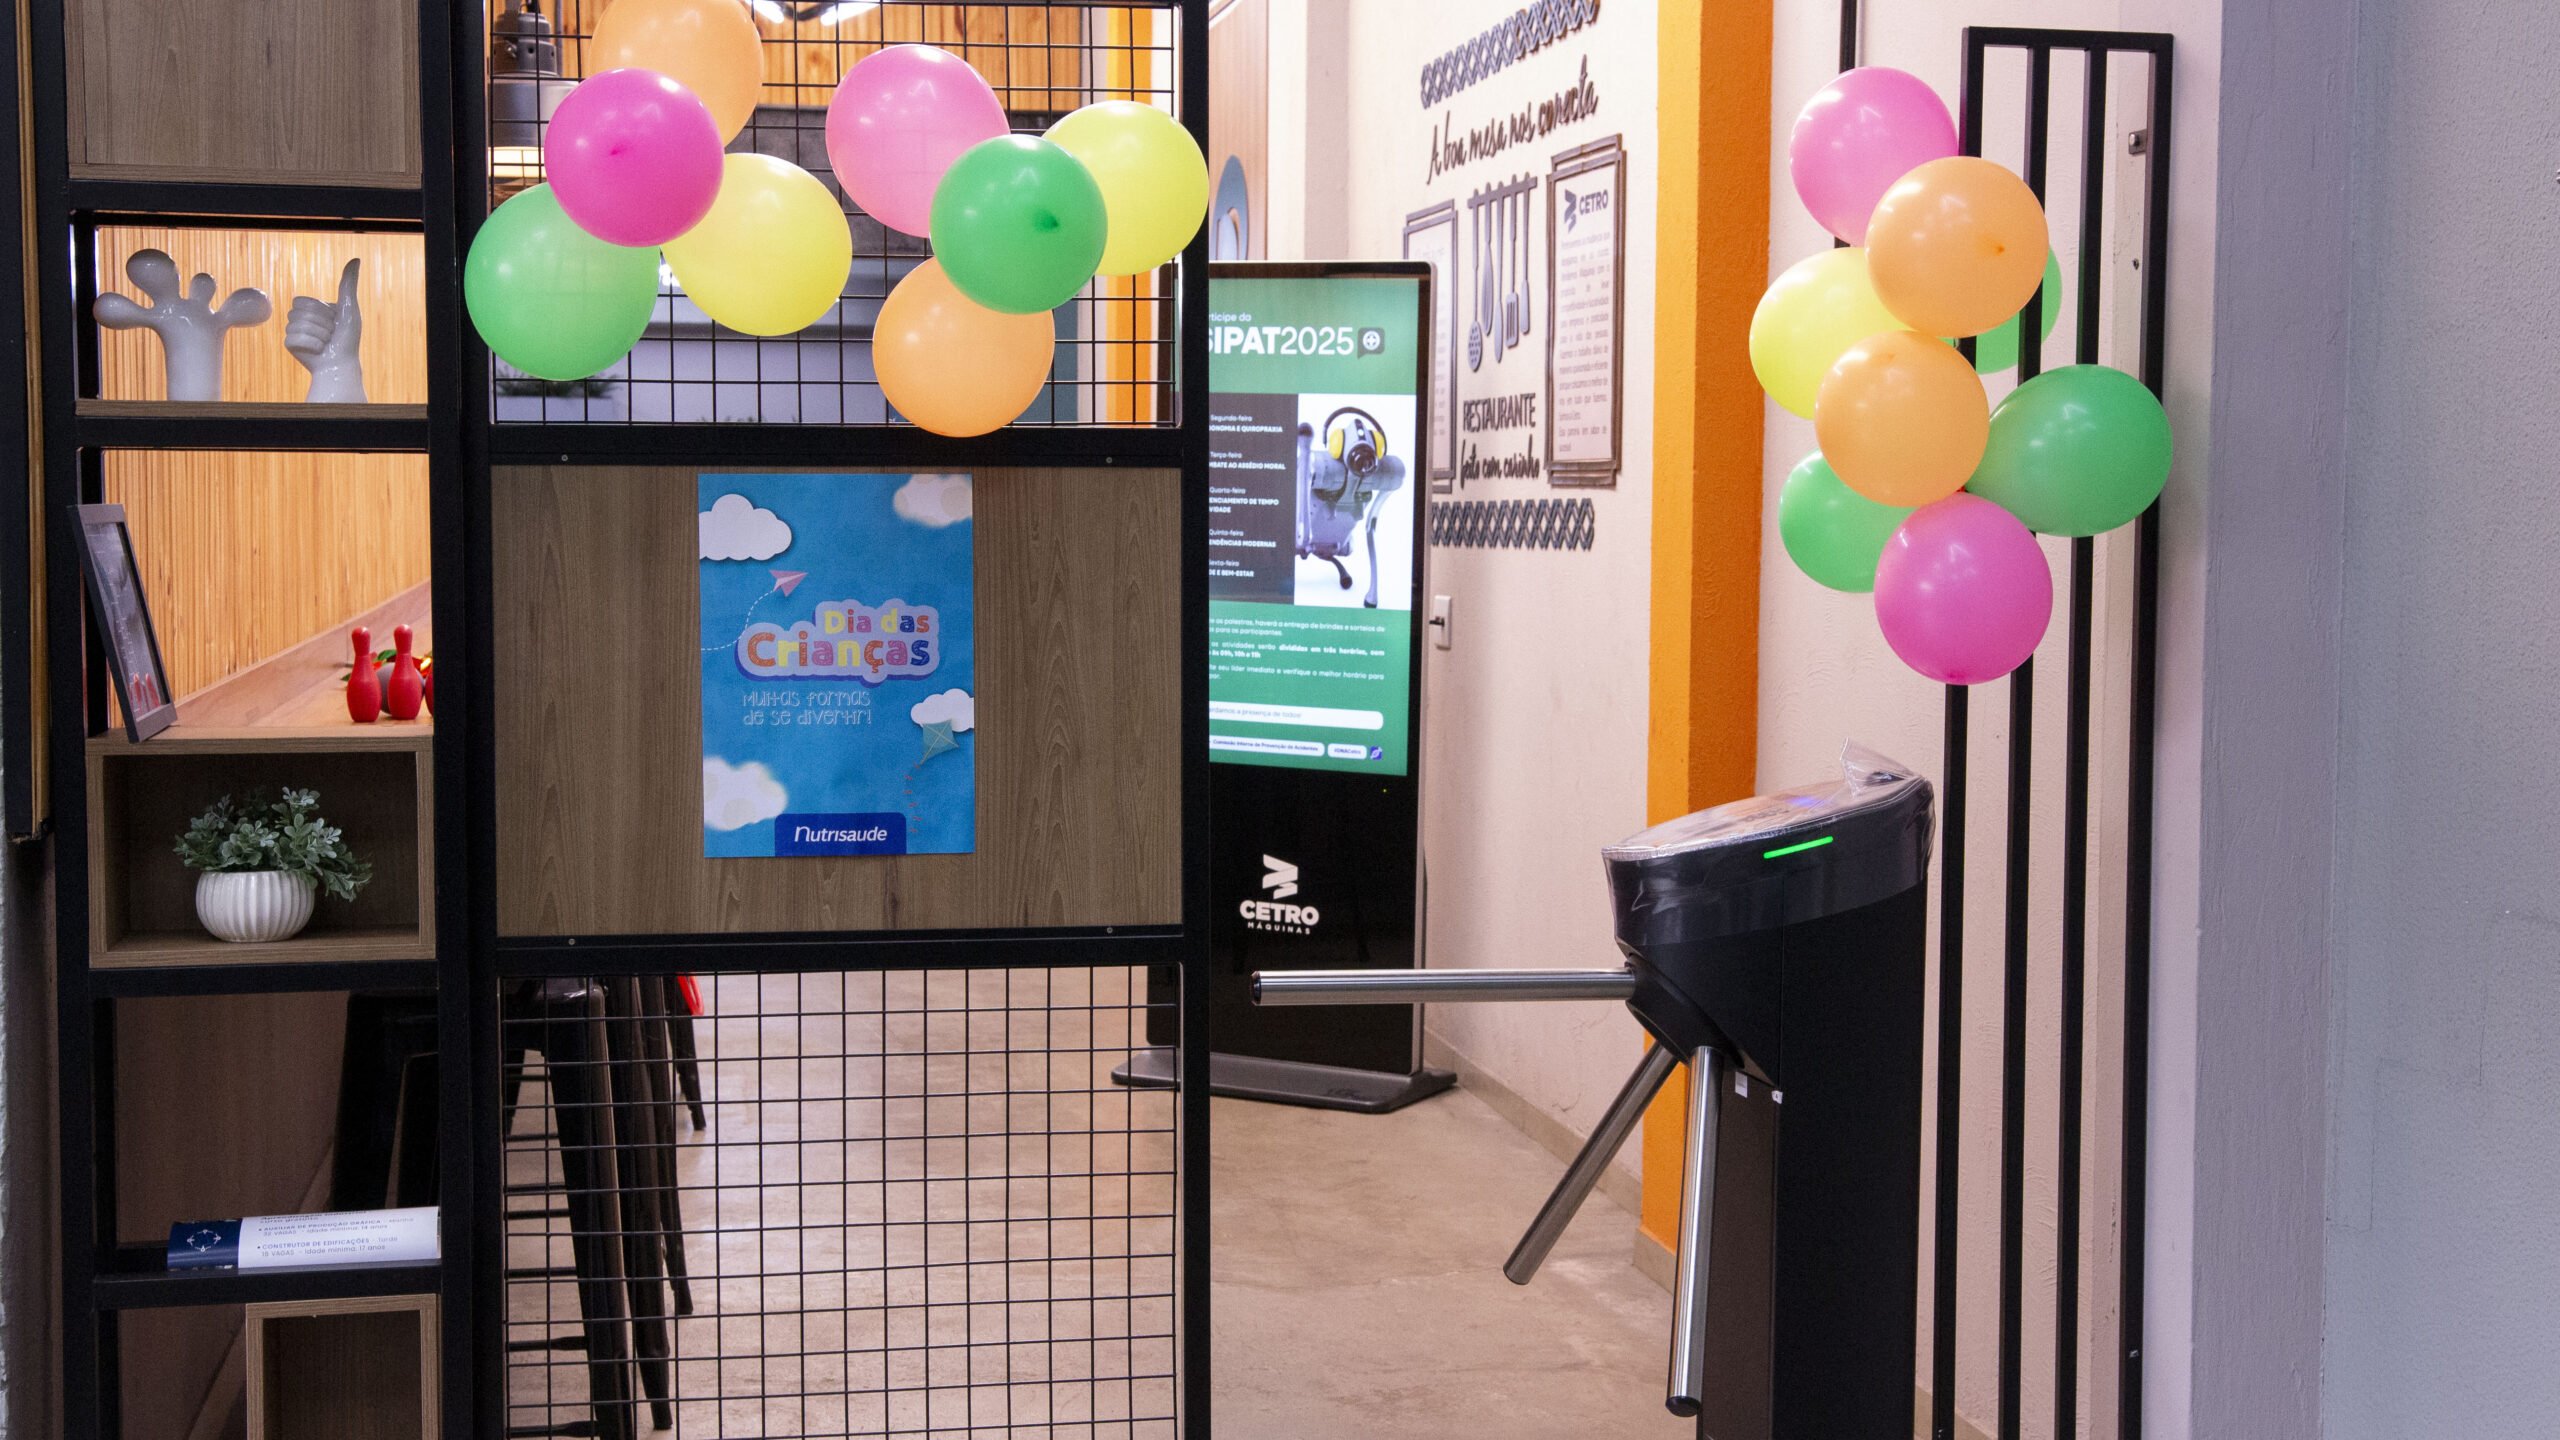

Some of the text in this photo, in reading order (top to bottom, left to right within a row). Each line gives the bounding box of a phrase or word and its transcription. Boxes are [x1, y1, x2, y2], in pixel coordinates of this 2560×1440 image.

[1443, 110, 1467, 171] boa
[1469, 117, 1508, 162] mesa
[1509, 101, 1536, 149] nos
[1579, 189, 1609, 216] CETRO
[1210, 414, 1253, 422] Segunda-feira
[1462, 392, 1536, 433] RESTAURANTE
[1241, 425, 1283, 433] QUIROPRAXIA
[1210, 451, 1243, 459] Terça-feira
[1460, 433, 1540, 490] feito com carinho
[1238, 461, 1263, 470] ASSÉDIO
[1264, 462, 1286, 470] MORAL
[1209, 486, 1246, 494] Quarta-feira
[1242, 540, 1276, 548] MODERNAS
[1221, 569, 1254, 577] BEM-ESTAR
[824, 608, 930, 634] Dia das
[747, 630, 931, 674] Crianças
[1279, 644, 1308, 652] divididas
[806, 690, 872, 706] formas
[743, 708, 872, 726] de se divertir!
[1239, 899, 1320, 926] CETRO
[1247, 921, 1311, 935] MÁQUINAS
[308, 1220, 349, 1228] PRODUÇÃO
[350, 1218, 381, 1226] GRÁFICA
[262, 1241, 311, 1250] CONSTRUTOR
[323, 1237, 370, 1247] EDIFICAÇÕES
